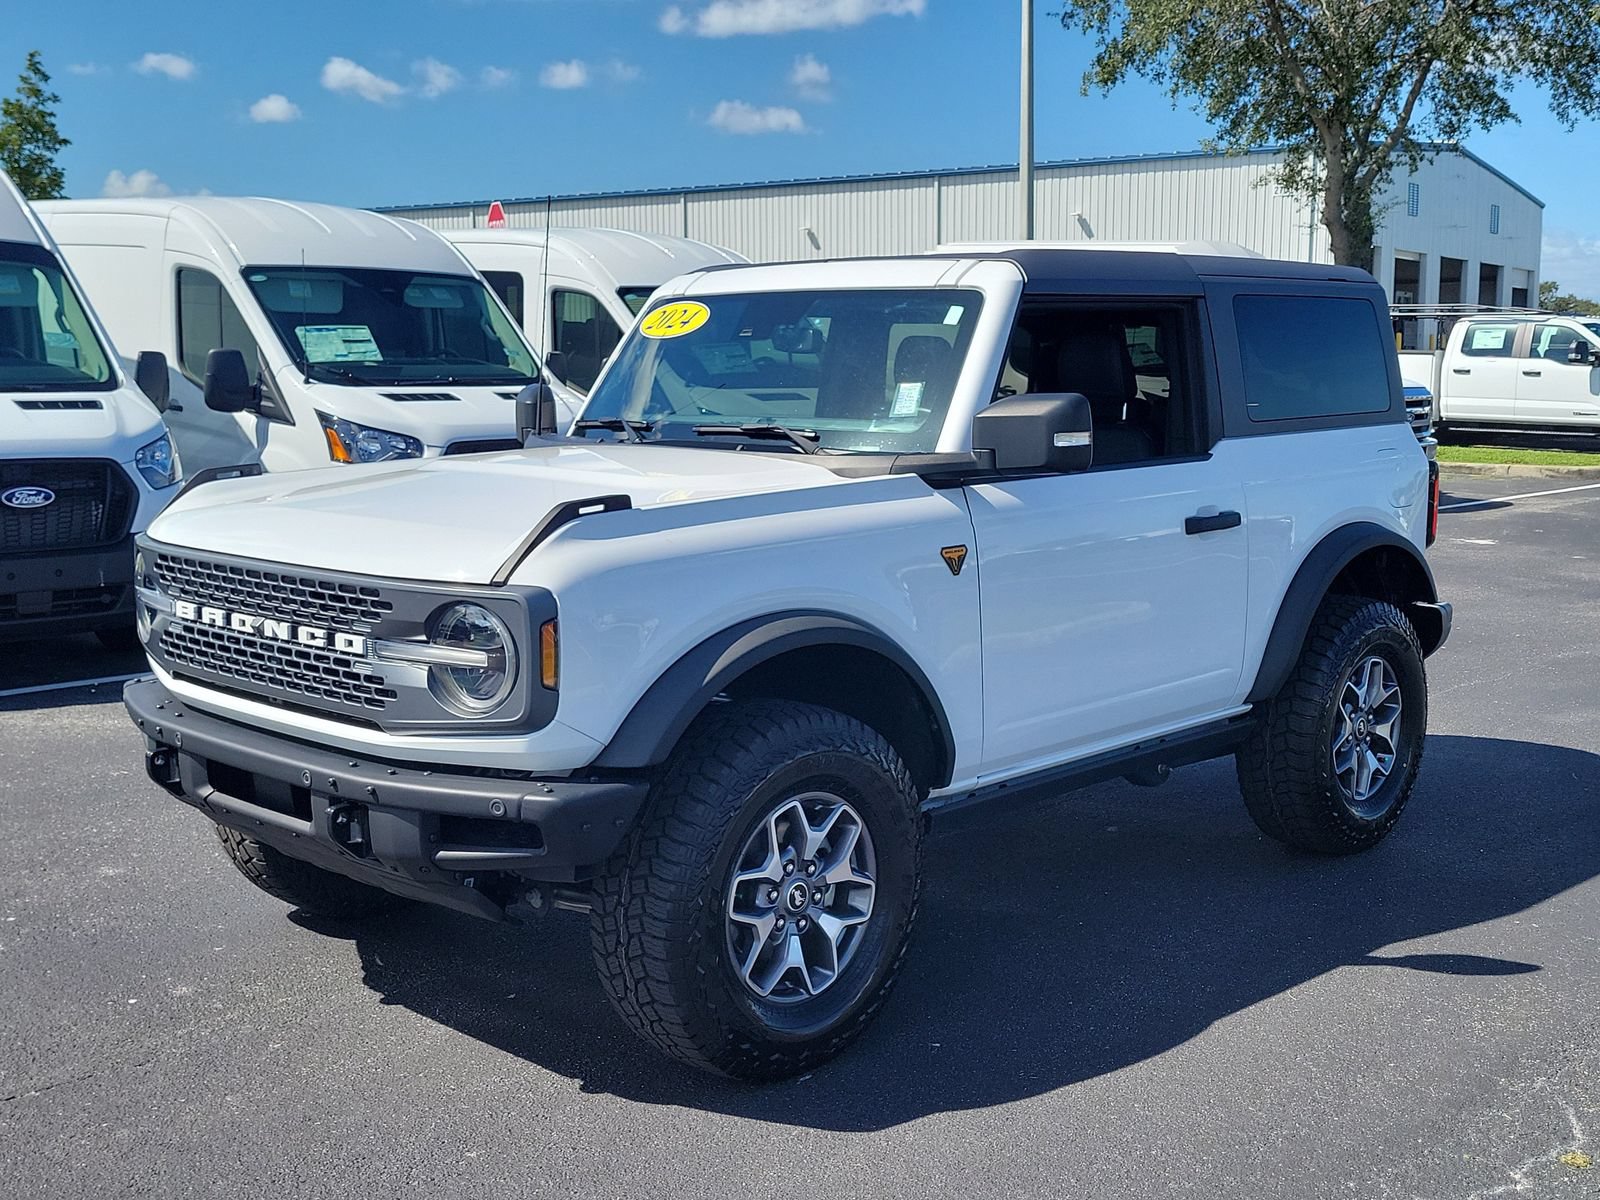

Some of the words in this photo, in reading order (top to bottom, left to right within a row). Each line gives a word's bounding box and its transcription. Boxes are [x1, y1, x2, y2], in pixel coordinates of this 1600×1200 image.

[645, 309, 702, 330] 2024
[12, 490, 45, 504] Ford
[175, 600, 367, 656] BRONCO
